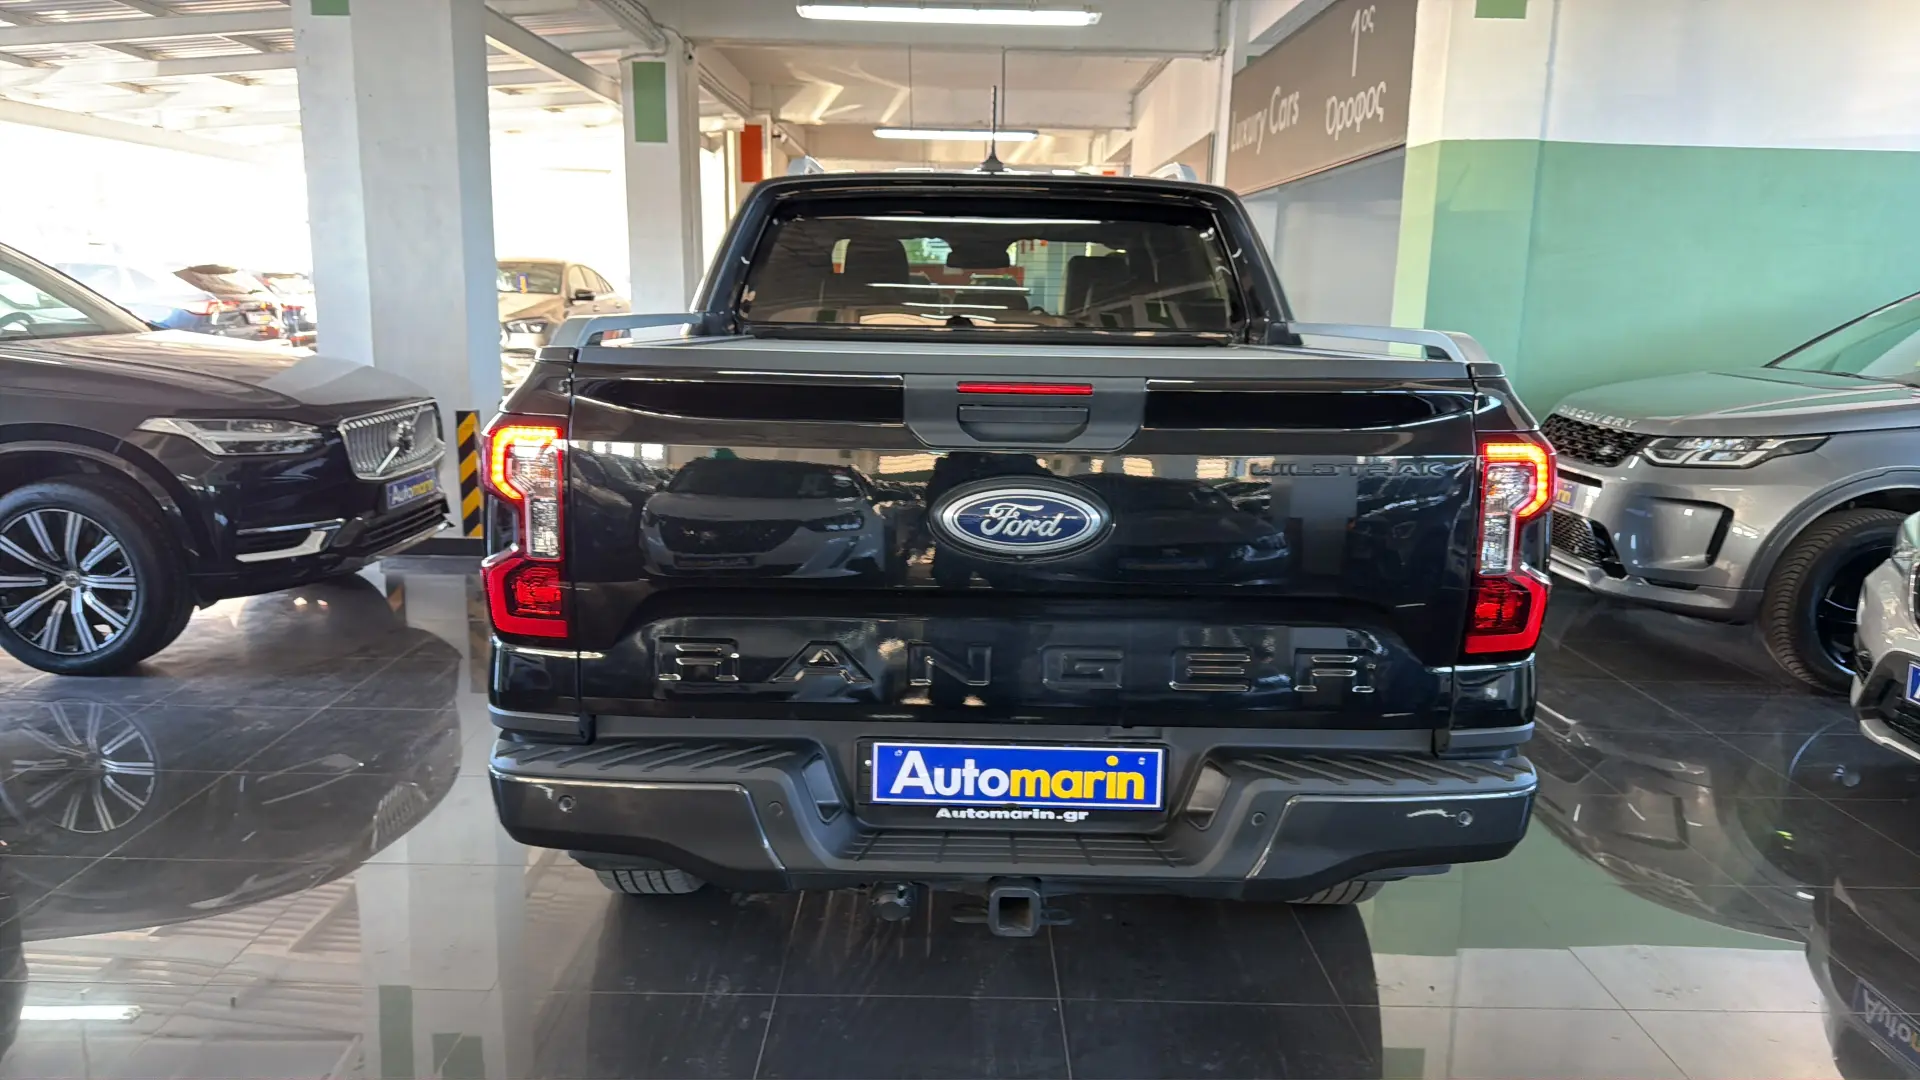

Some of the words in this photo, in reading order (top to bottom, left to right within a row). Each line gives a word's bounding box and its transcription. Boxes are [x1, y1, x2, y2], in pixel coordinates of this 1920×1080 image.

[1268, 86, 1300, 135] Cars
[1559, 404, 1638, 429] DISCOVERY
[1250, 462, 1445, 477] WILDTRAK
[980, 502, 1065, 537] Ford
[656, 636, 1376, 694] RANGER
[889, 750, 1146, 800] Automarin
[935, 807, 1090, 823] Automarin.gr
